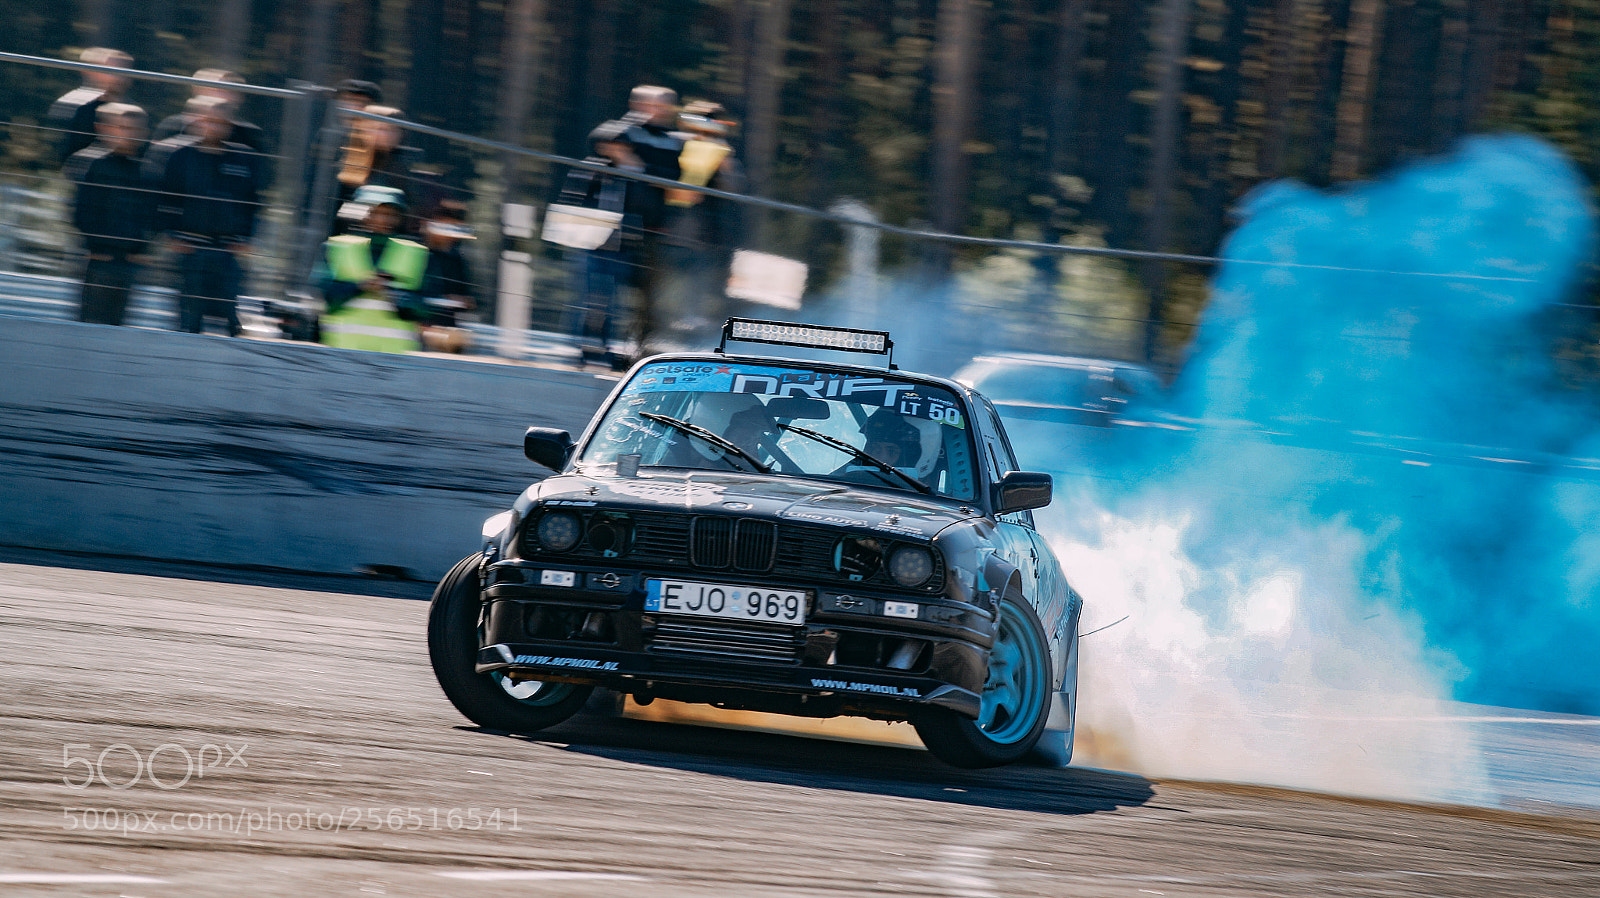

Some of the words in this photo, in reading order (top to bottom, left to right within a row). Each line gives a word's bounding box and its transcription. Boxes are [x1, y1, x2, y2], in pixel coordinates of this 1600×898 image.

[642, 365, 713, 375] betsafe
[731, 374, 915, 407] DRIFT
[900, 401, 921, 416] LT
[928, 402, 960, 425] 50
[646, 599, 660, 607] LT
[663, 584, 726, 613] EJO
[747, 591, 799, 620] 969
[514, 654, 620, 671] WWW.MPMOIL.NL
[810, 678, 922, 698] WWW.MPMOIL.NL
